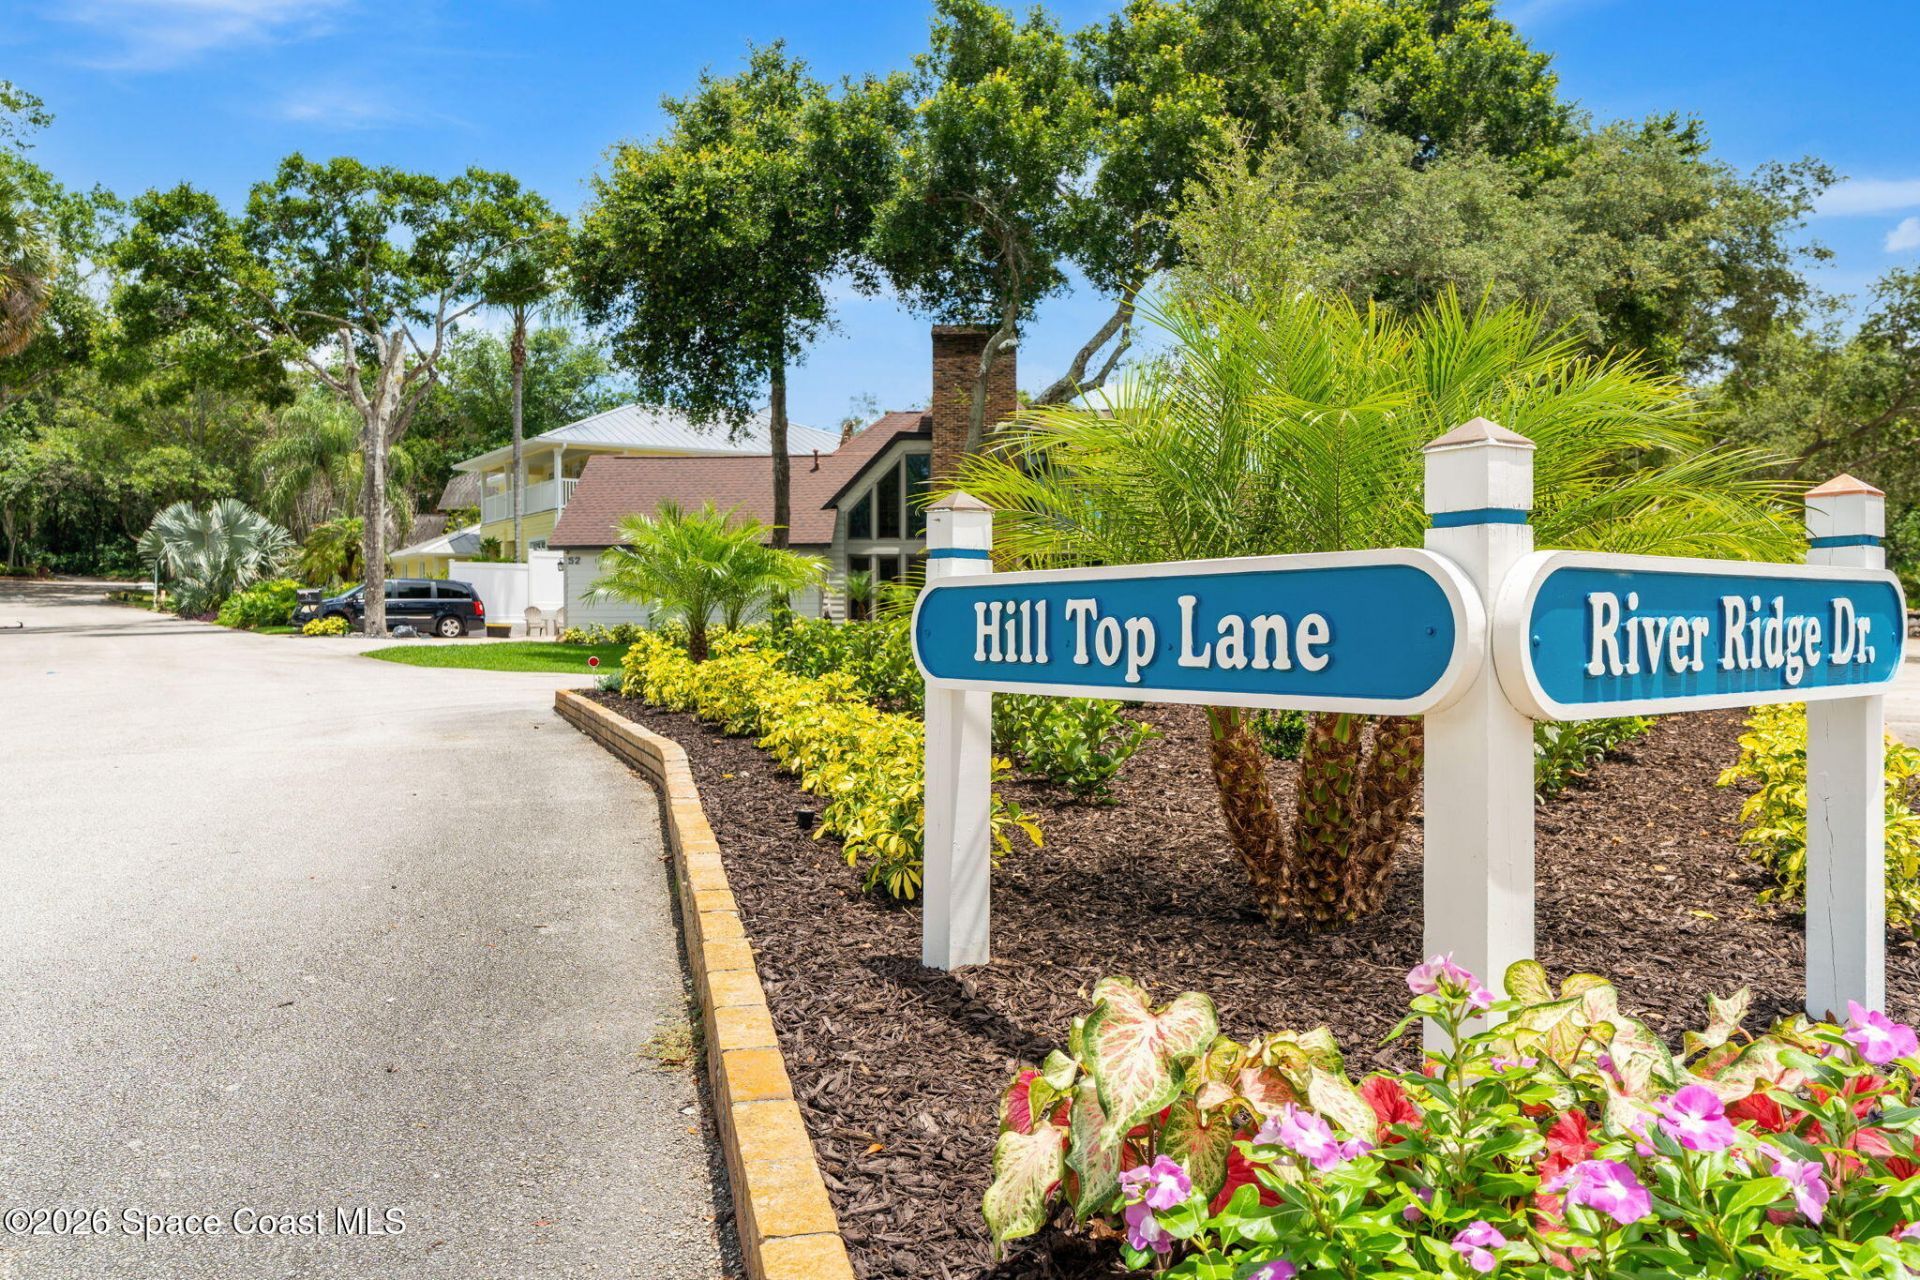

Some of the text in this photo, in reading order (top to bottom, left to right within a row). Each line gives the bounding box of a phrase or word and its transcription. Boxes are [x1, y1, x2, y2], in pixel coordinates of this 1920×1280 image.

[568, 556, 581, 565] 52
[974, 594, 1331, 684] Hill Top Lane
[1586, 591, 1876, 686] River Ridge Dr.
